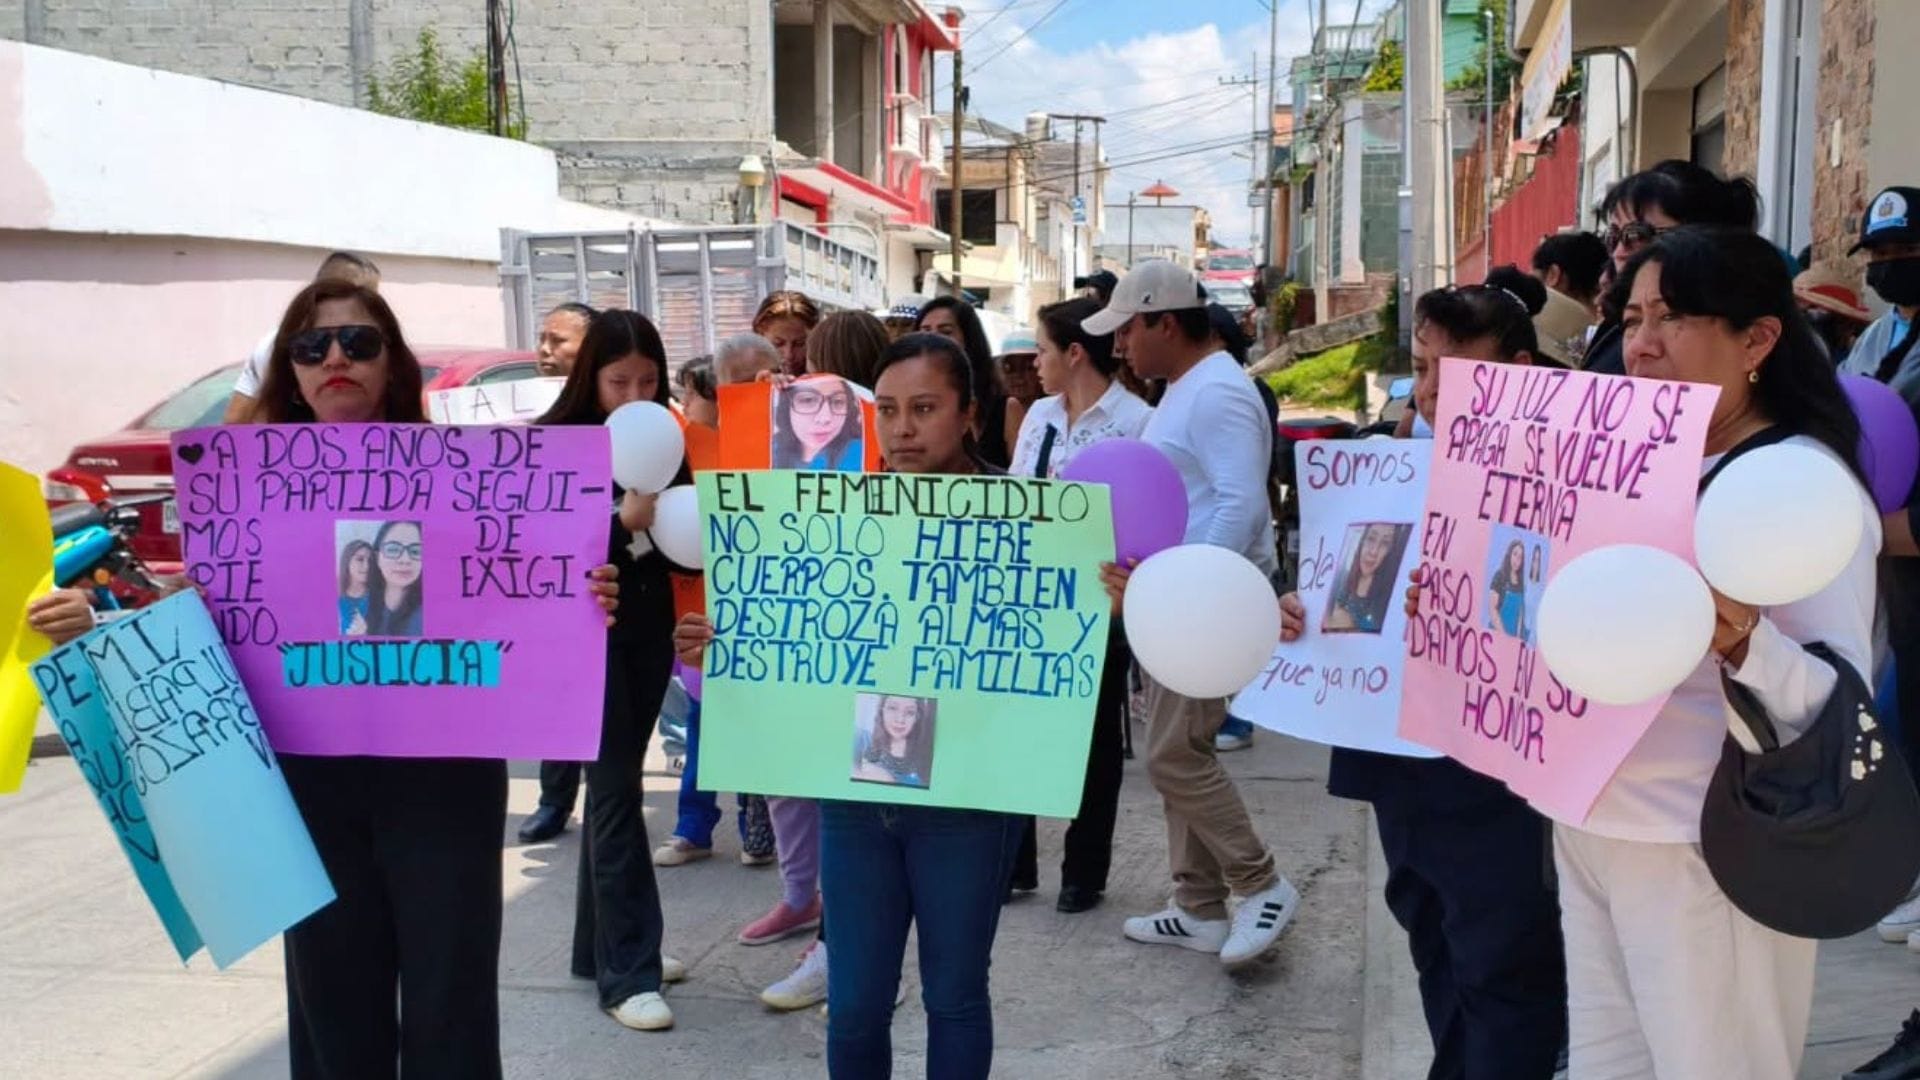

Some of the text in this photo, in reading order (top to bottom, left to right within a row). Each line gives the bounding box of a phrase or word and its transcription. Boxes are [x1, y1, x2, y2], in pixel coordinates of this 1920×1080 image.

[1472, 363, 1690, 444] SU LUZ NO SE
[212, 426, 543, 470] A DOS AÑOS DE
[1446, 415, 1658, 499] APAGA SE VUELVE
[189, 472, 241, 515] SU
[256, 468, 433, 512] PARTIDA
[452, 471, 606, 513] SEGUI-
[717, 472, 1089, 522] EL FEMINICIDIO
[1478, 470, 1578, 543] ETERNA
[183, 515, 523, 559] MOS DE
[709, 512, 1034, 565] NO SOLO HIERE
[1300, 536, 1334, 590] de
[1422, 512, 1458, 562] EN
[711, 555, 1077, 611] CUERPOS. TAMBIEN
[1419, 561, 1474, 623] PASO
[219, 606, 279, 647] DO
[714, 599, 1099, 653] DESTROZA ALMAS Y
[706, 639, 1095, 699] DESTRUYE FAMILIAS
[1262, 656, 1388, 705] que ya no
[1409, 609, 1498, 684] DAMOS
[1513, 641, 1536, 700] EN
[1462, 681, 1545, 764] HONOR
